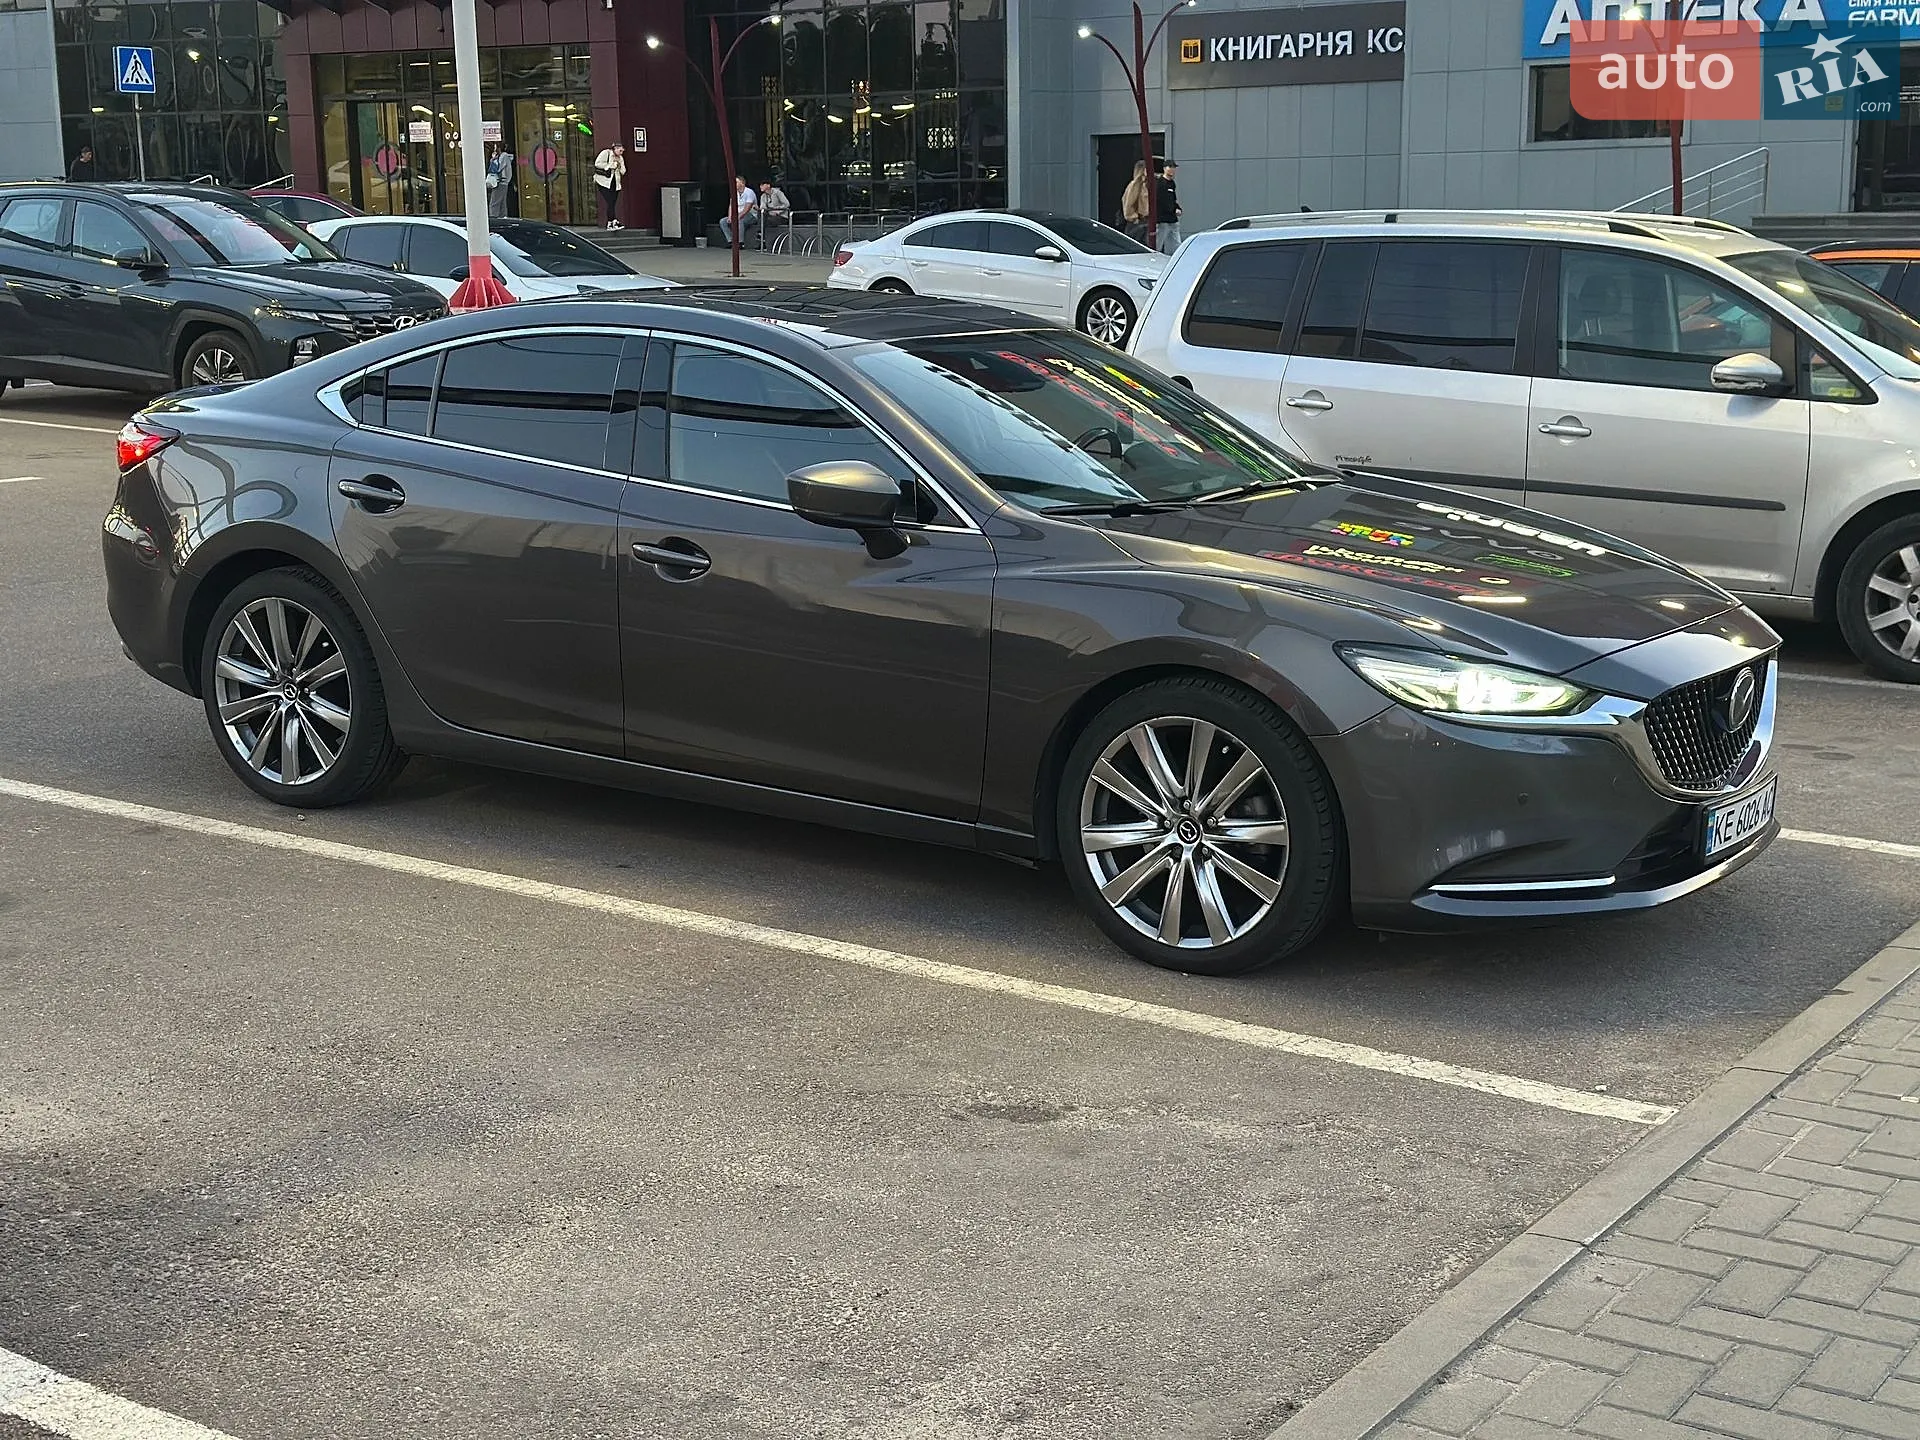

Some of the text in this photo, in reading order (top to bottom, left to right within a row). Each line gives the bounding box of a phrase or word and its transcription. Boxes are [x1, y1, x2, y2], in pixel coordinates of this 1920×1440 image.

[1540, 0, 1827, 44] АПТЕКА
[1210, 30, 1352, 62] КНИГАРНЯ
[1713, 809, 1735, 848] KE
[1736, 794, 1762, 837] 6026
